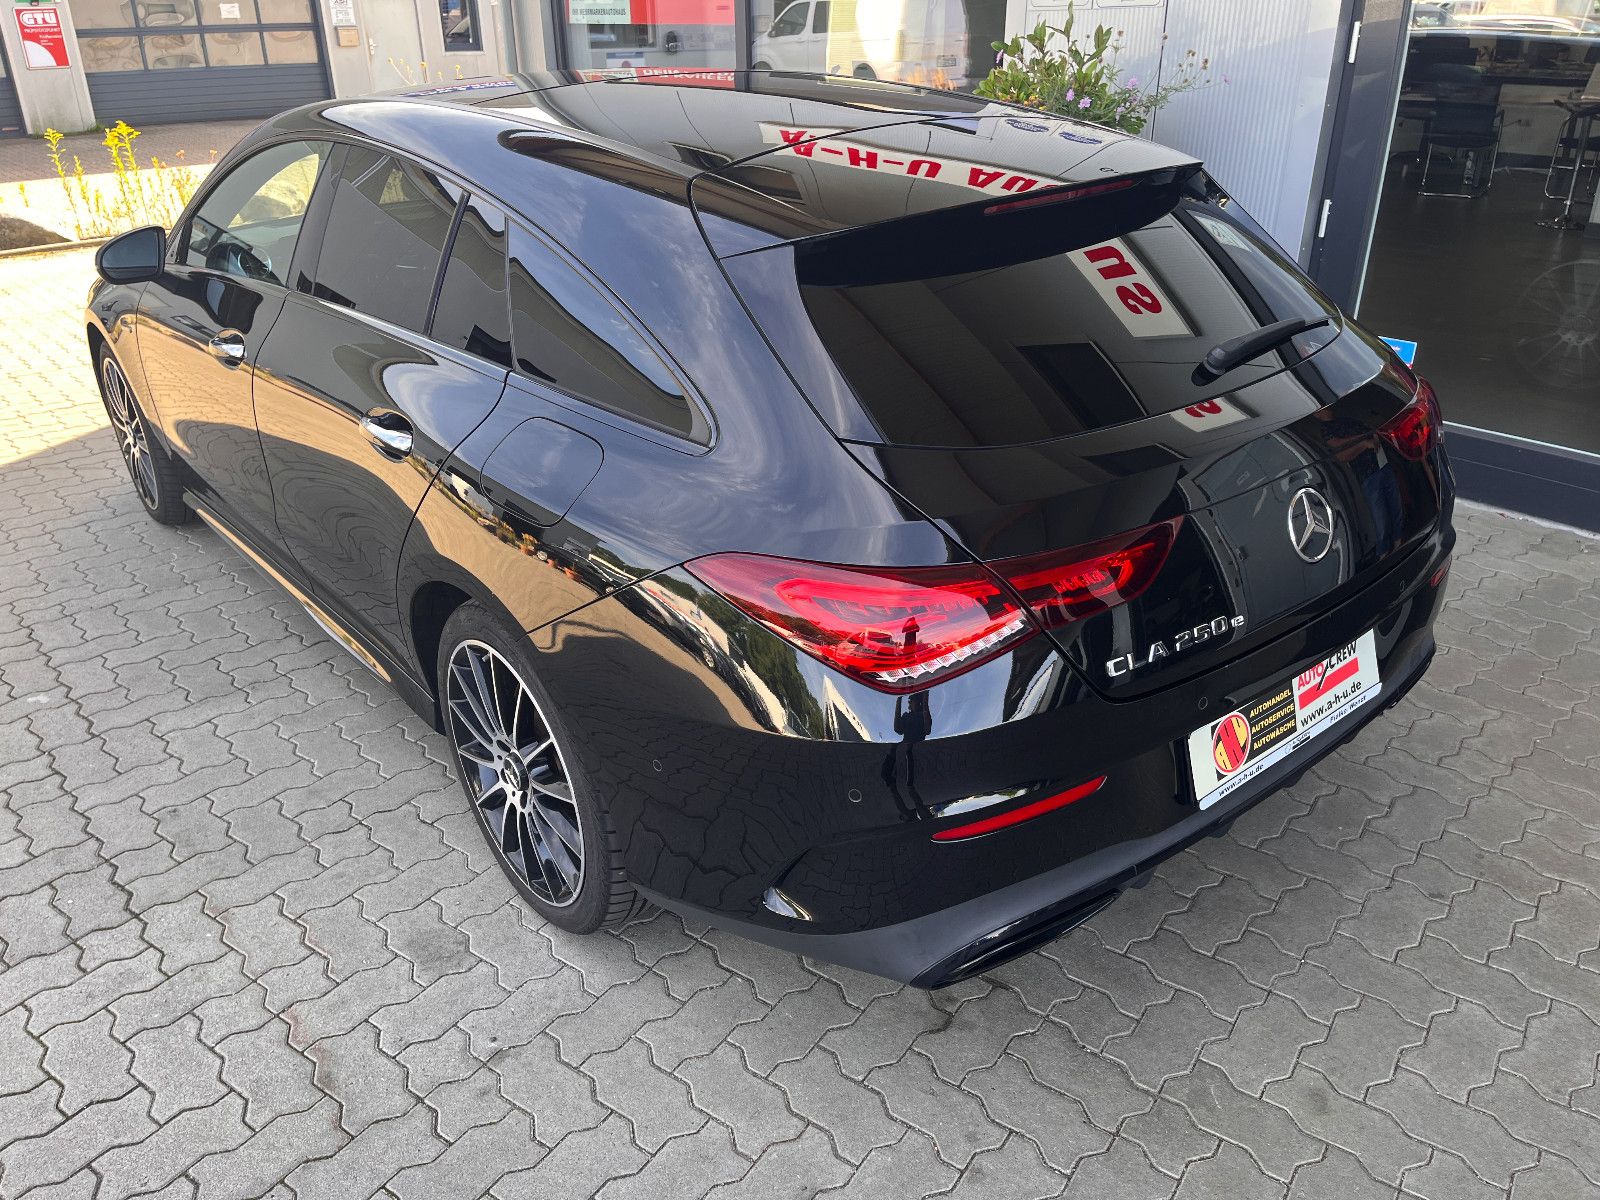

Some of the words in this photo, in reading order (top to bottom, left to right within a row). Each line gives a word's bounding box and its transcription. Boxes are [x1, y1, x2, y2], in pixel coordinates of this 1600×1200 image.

[22, 11, 57, 25] GTÜ
[1106, 641, 1170, 678] CLA
[1249, 688, 1292, 718] AUTOHANDEL
[1251, 703, 1295, 734] AUTOSERVICE
[1301, 680, 1362, 728] www.a-h-u.de
[1253, 719, 1296, 750] AUTOWÄSCHE
[1219, 764, 1264, 796] www.a-h-u.de
